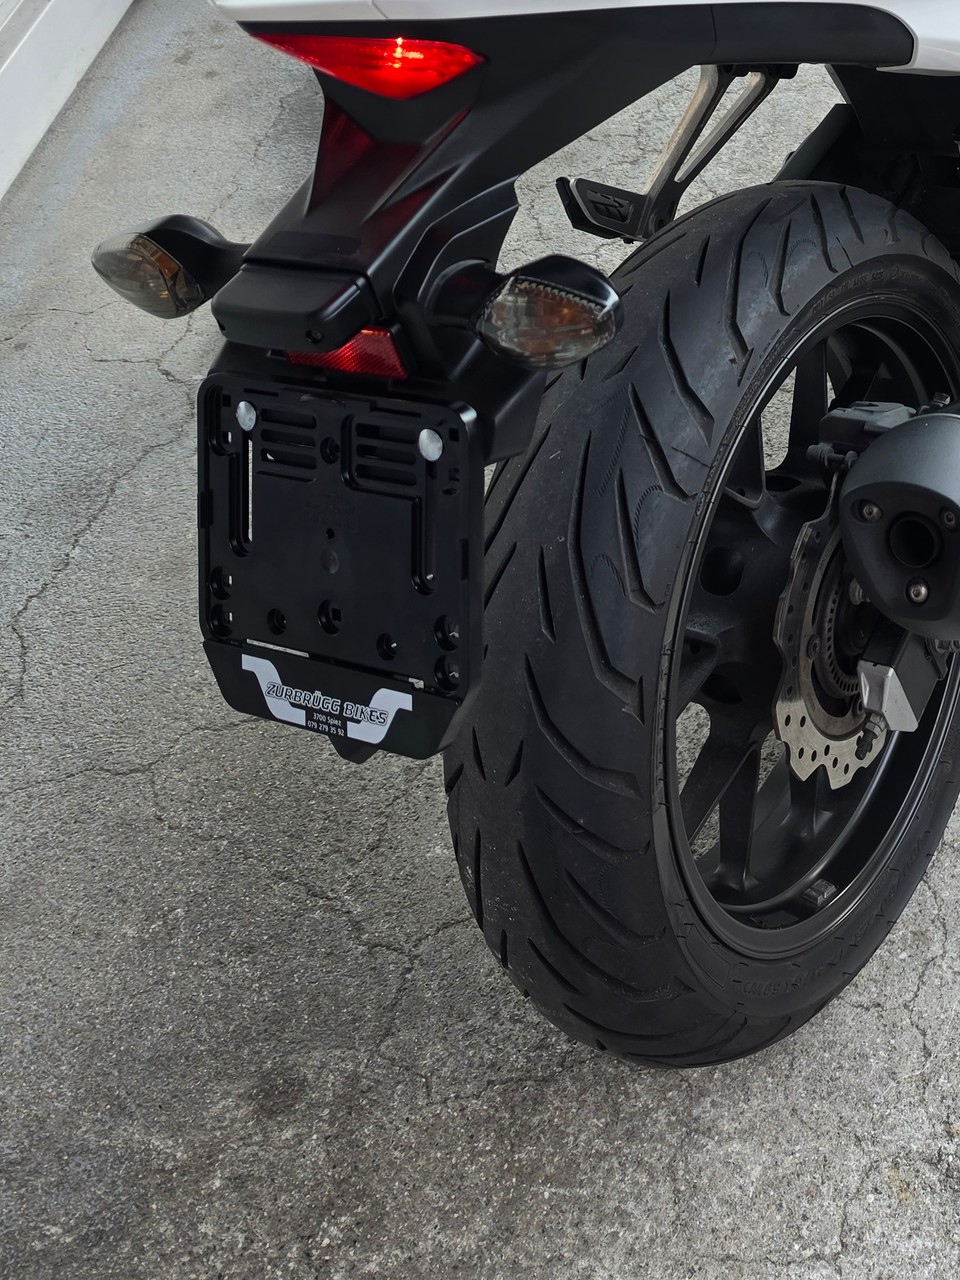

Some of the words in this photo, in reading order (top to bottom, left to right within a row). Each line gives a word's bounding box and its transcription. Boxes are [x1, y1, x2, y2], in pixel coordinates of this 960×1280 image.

[265, 682, 341, 714] ZURBRÜGG
[343, 701, 389, 726] BIKES
[307, 720, 317, 729] 079
[318, 723, 329, 732] 279
[313, 712, 327, 722] 3700
[327, 714, 342, 726] Spiez
